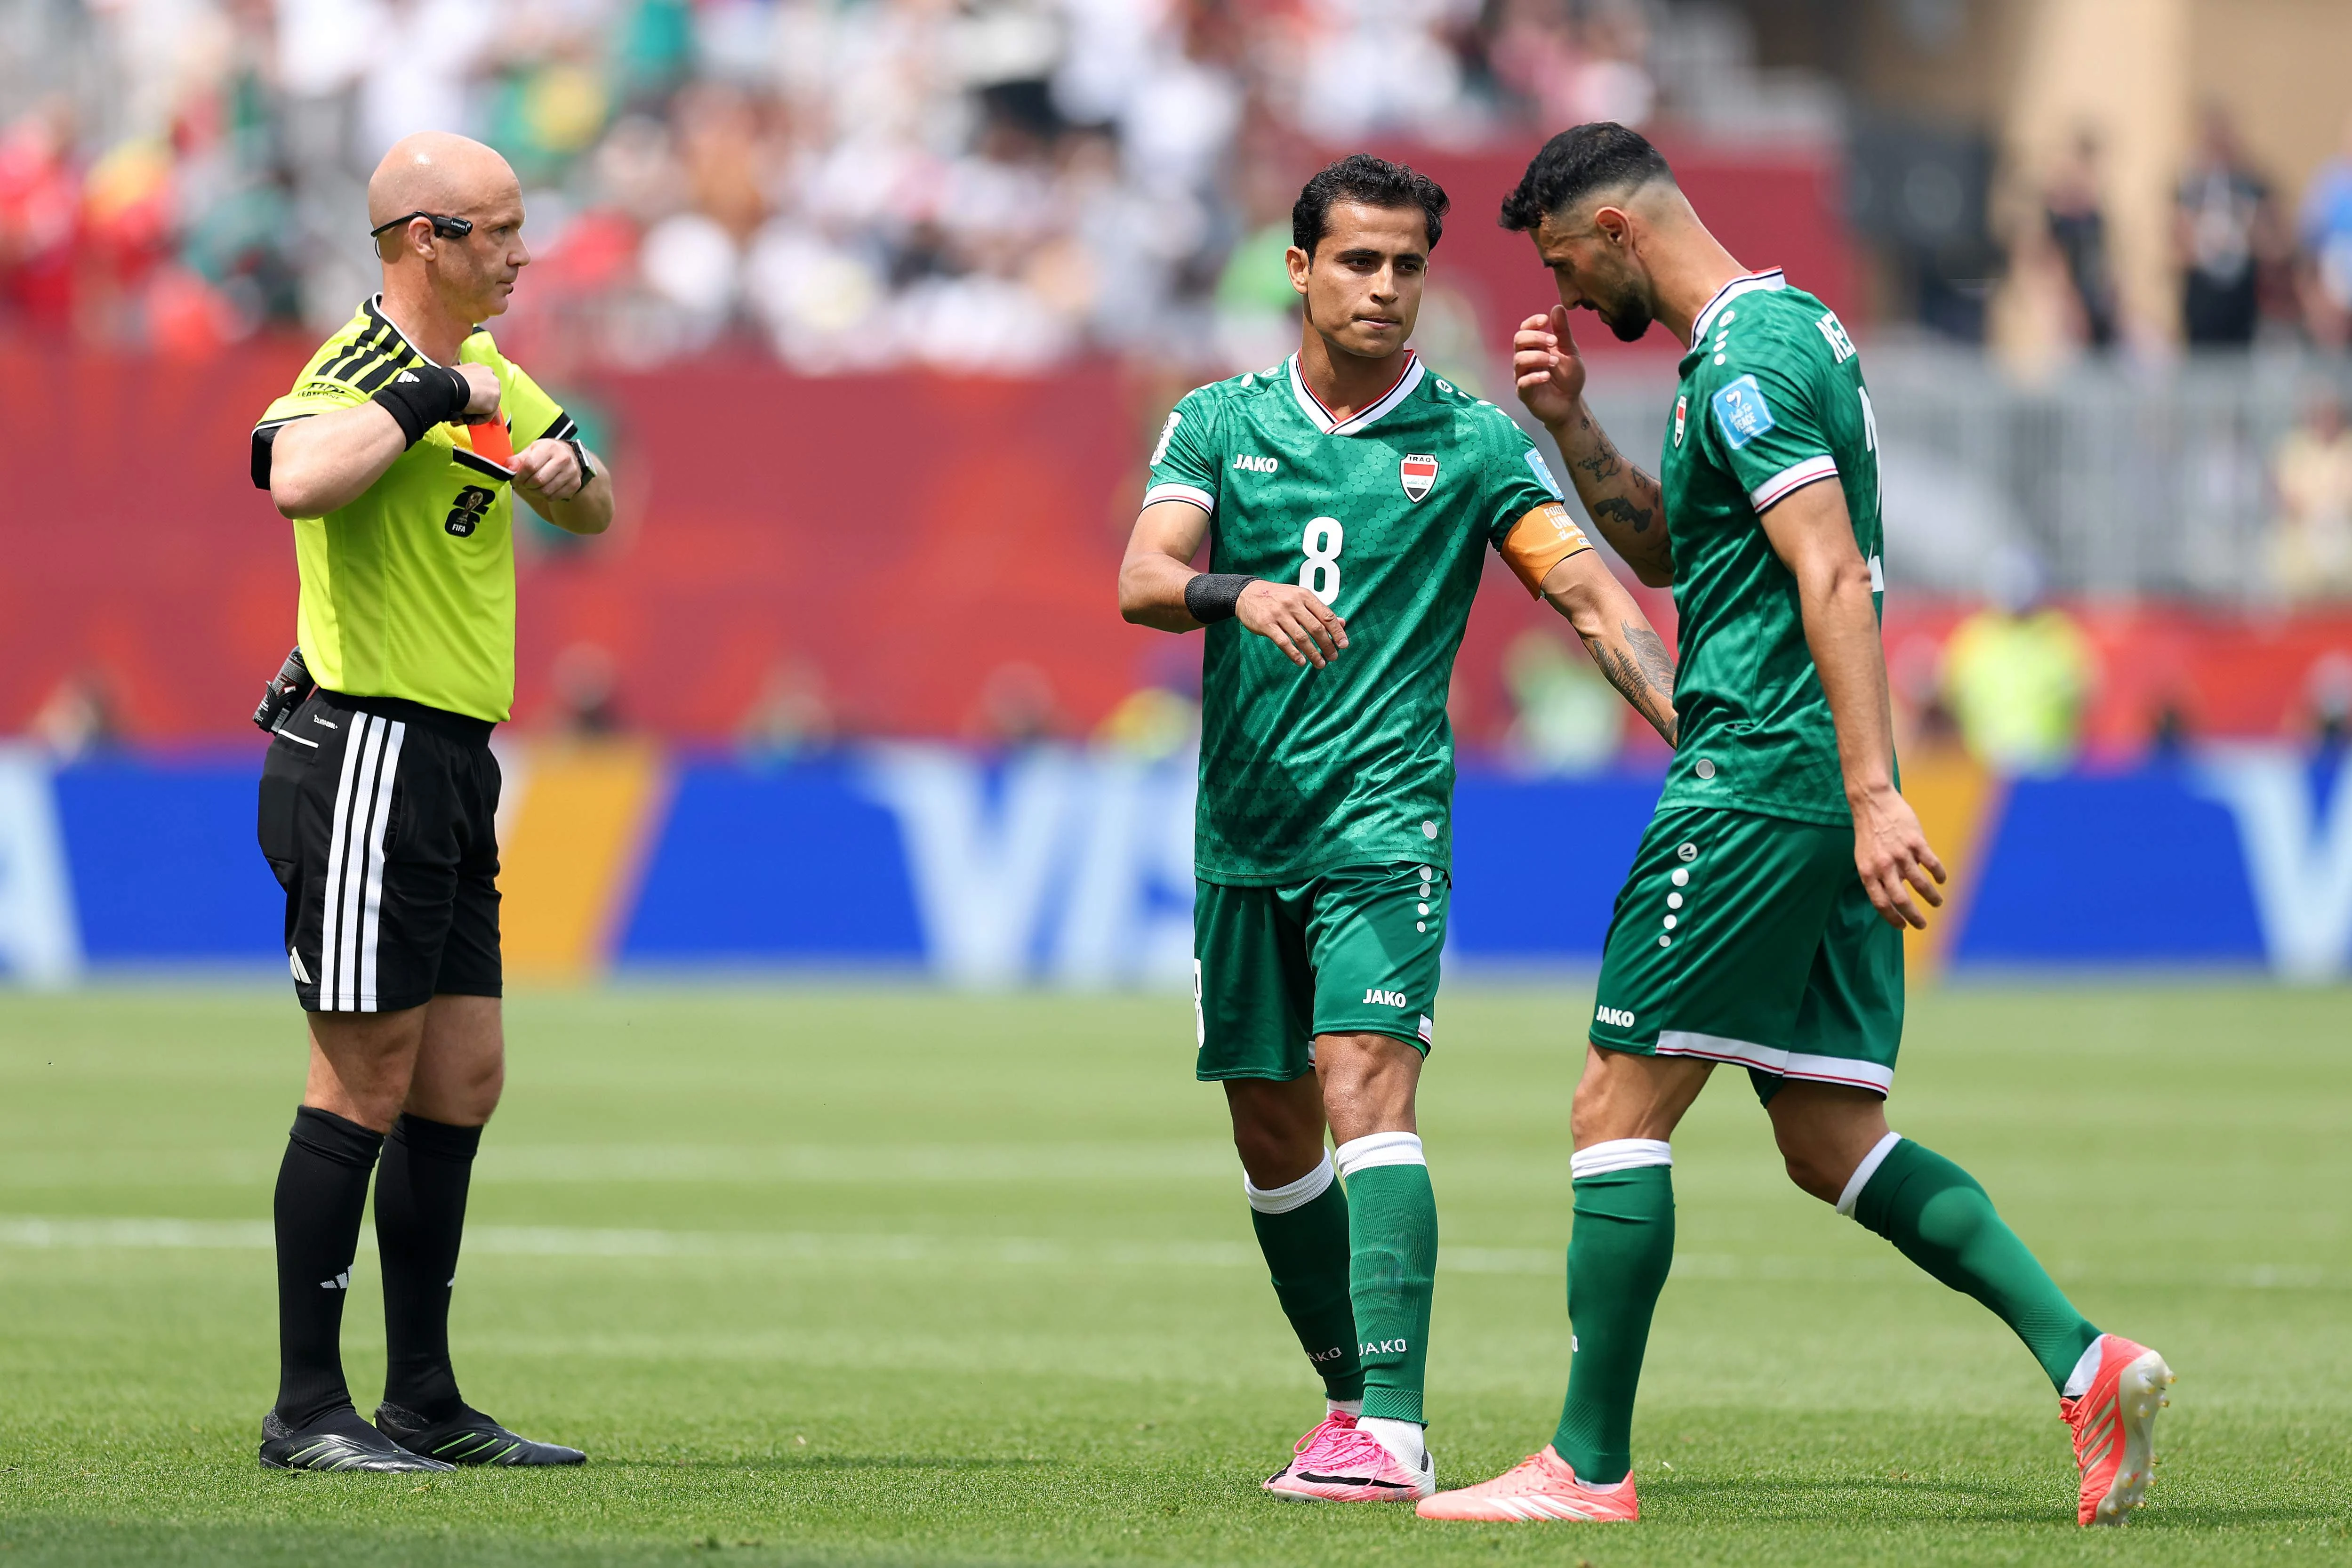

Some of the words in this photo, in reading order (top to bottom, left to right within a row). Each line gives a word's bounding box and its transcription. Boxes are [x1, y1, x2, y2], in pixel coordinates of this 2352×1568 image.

[451, 221, 465, 229] Lenovo
[1815, 310, 1856, 364] RE
[1233, 454, 1278, 473] JAKO
[1544, 505, 1567, 518] FOOT
[452, 523, 466, 533] FIFA
[1299, 516, 1343, 606] 8
[866, 744, 1196, 984] VIS
[1363, 989, 1406, 1008] JAKO
[1596, 1005, 1635, 1028] JAKO
[1307, 1347, 1342, 1362] AKO
[1358, 1338, 1407, 1356] JAKO
